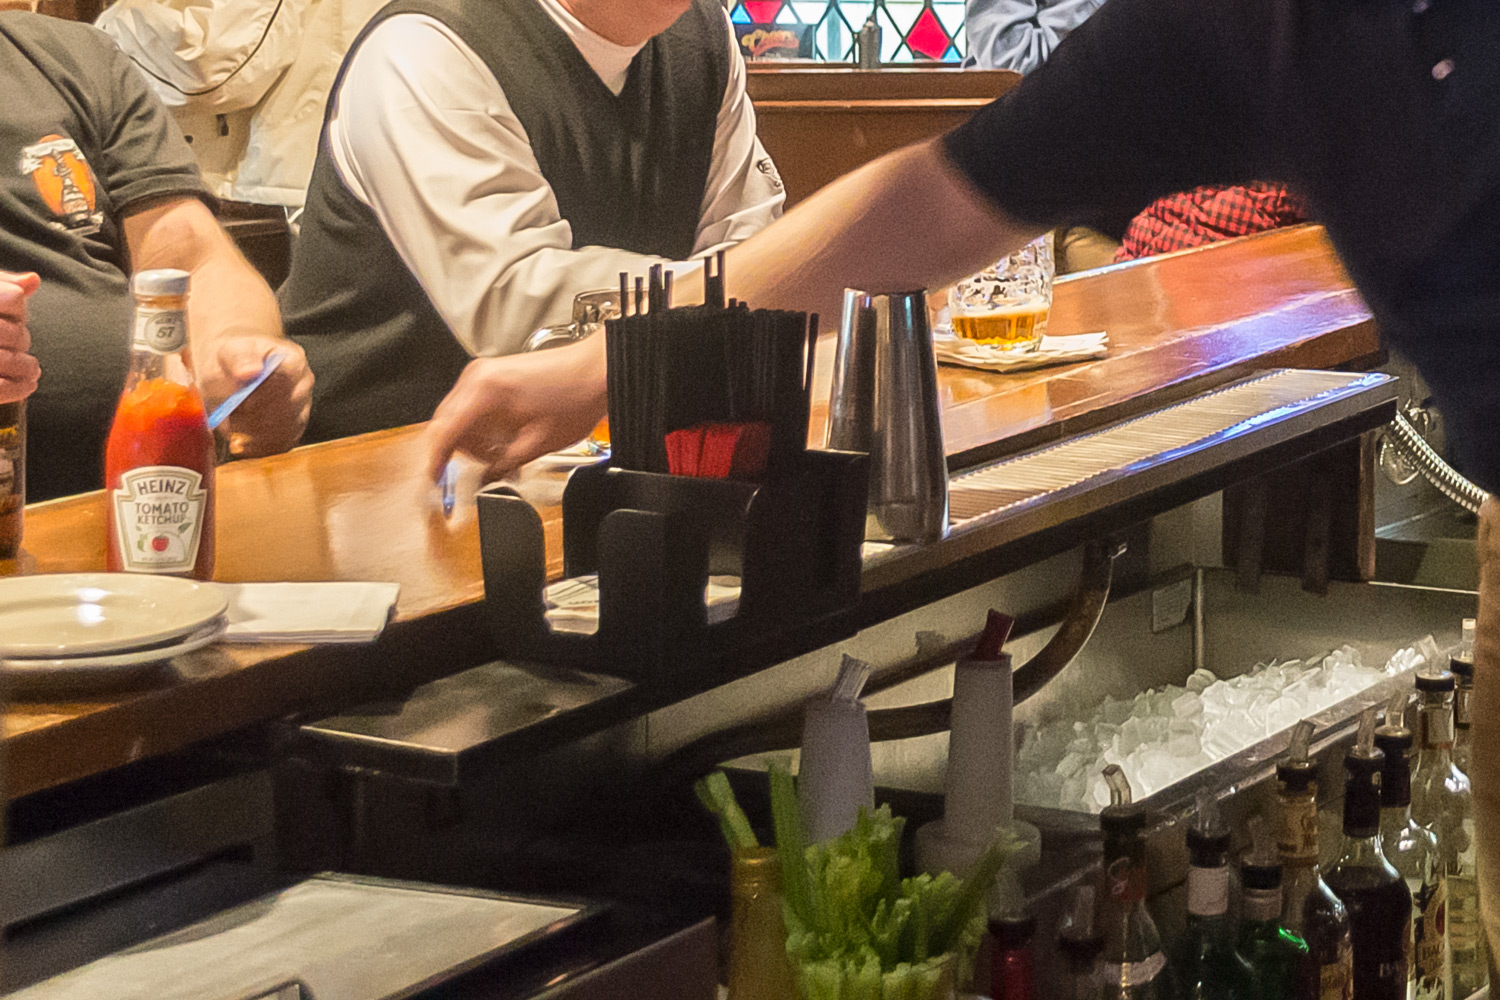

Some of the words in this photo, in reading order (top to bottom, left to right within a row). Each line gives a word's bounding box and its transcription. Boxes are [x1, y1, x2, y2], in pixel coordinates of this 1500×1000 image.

[156, 326, 175, 339] 57
[137, 480, 187, 495] HEINZ
[135, 502, 189, 515] TOMATO
[137, 514, 187, 525] KETCHUP
